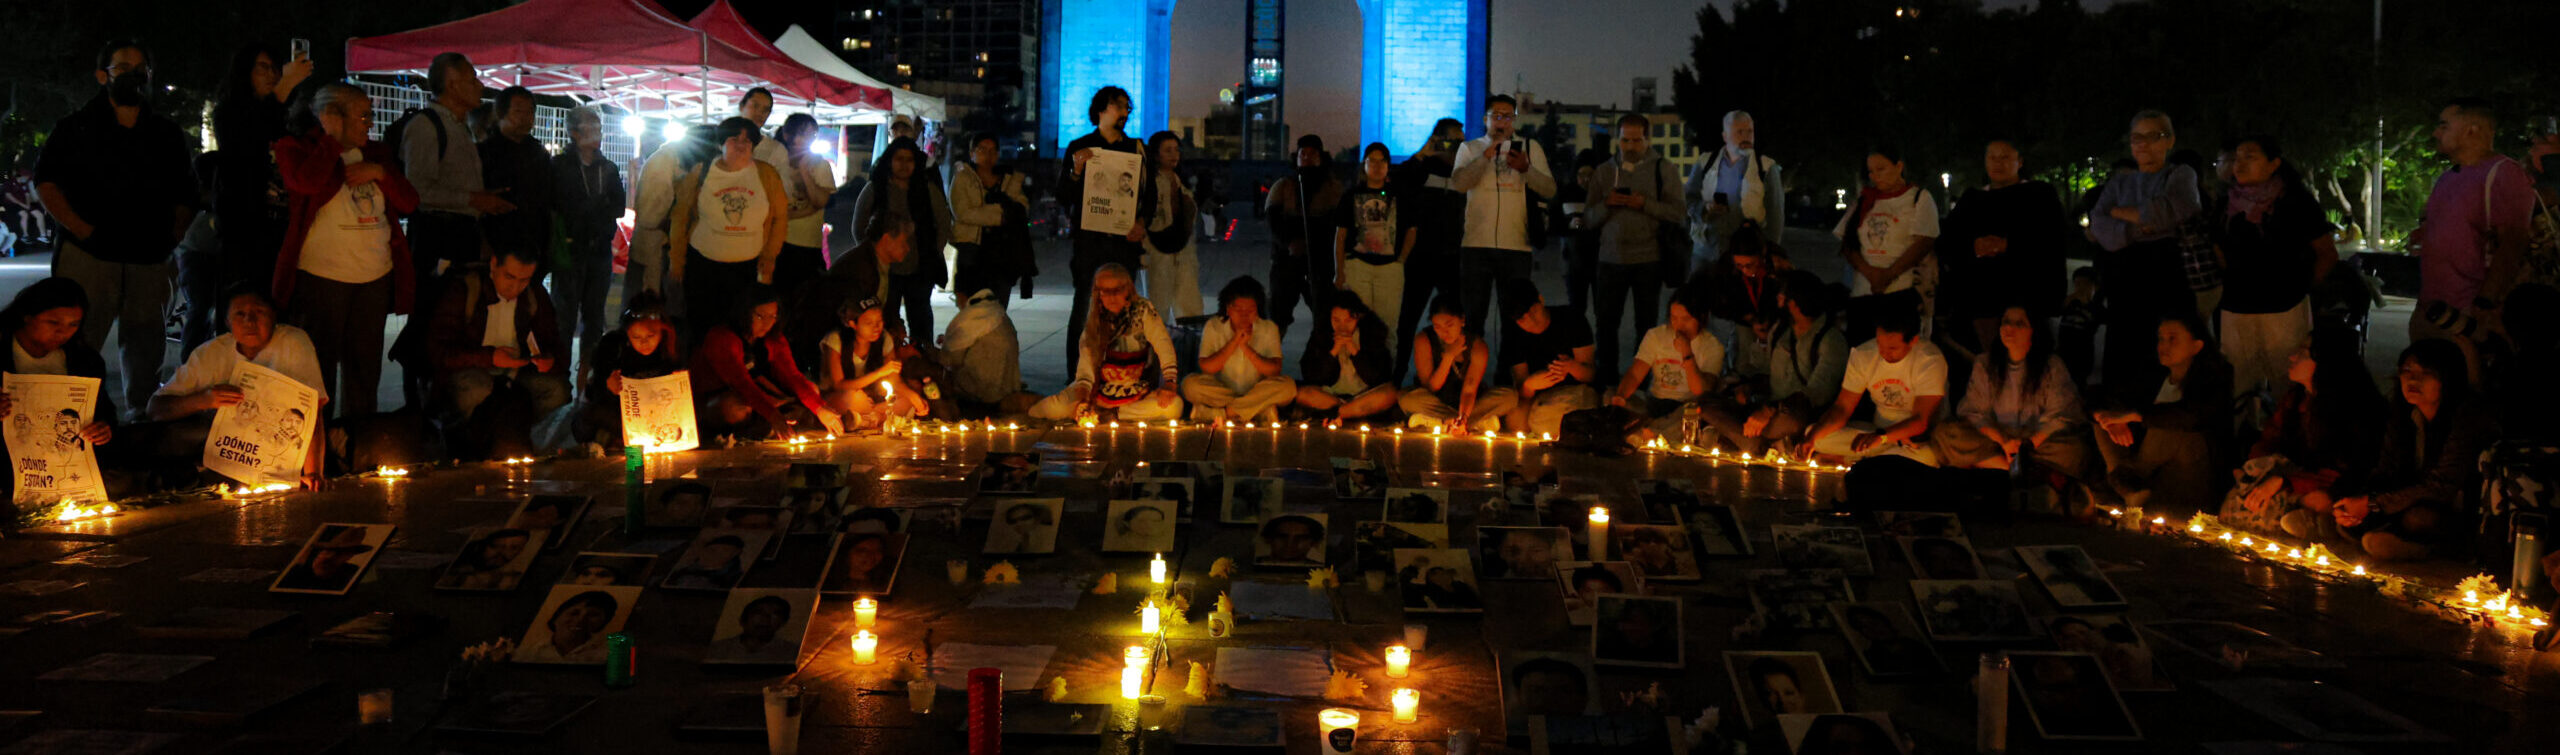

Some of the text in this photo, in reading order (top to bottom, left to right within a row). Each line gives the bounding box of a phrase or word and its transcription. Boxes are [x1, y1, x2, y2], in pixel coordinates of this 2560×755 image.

[215, 435, 260, 456] ¿DÓNDE
[19, 456, 47, 473] ¿DÓNDE
[219, 447, 261, 468] ESTÁN?
[24, 472, 54, 488] ESTÁN?
